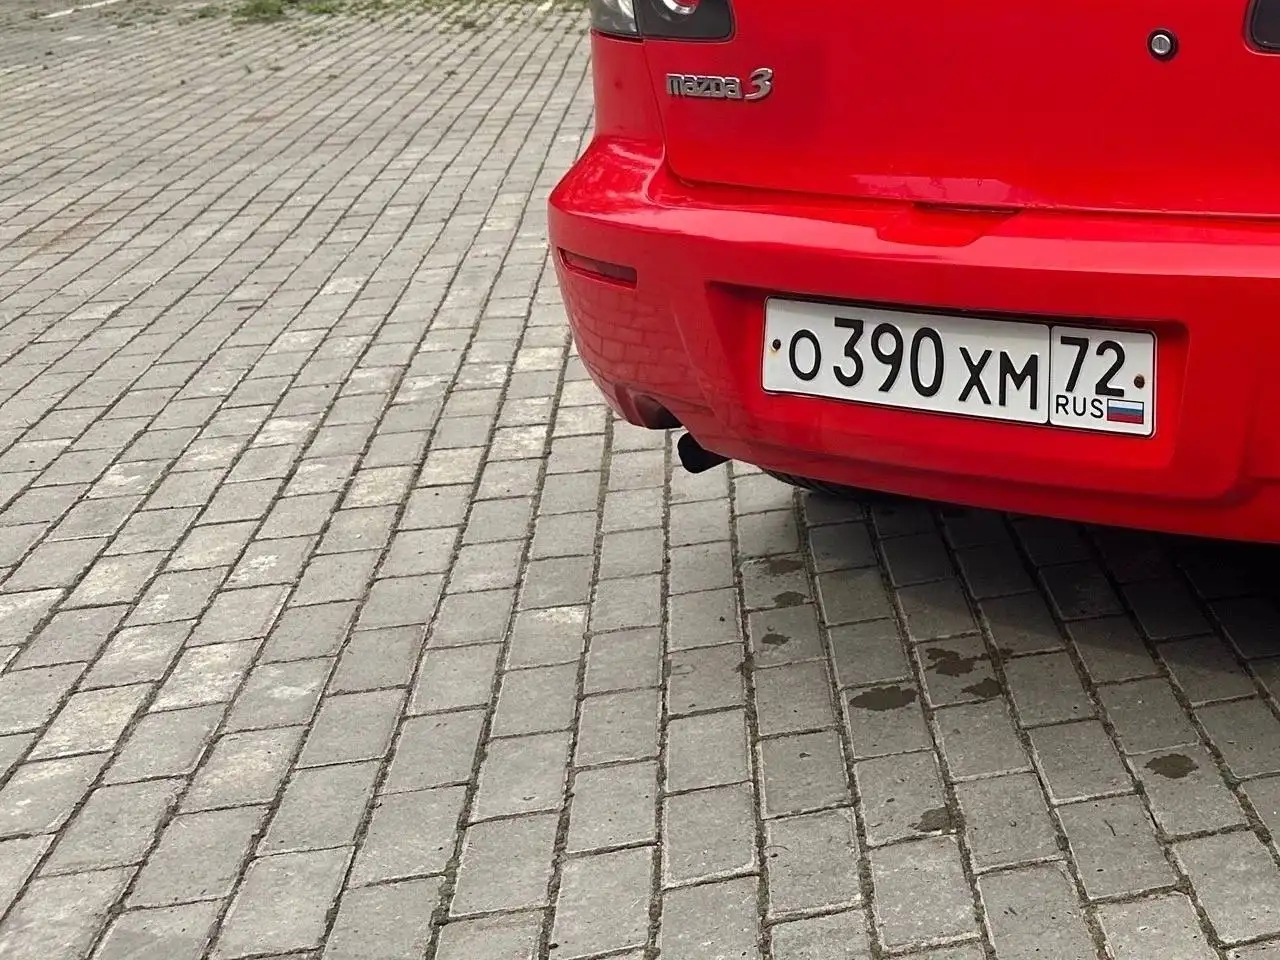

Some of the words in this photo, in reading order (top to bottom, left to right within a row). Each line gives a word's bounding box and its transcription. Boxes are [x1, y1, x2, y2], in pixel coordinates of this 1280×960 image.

[743, 67, 773, 100] 3
[1060, 336, 1126, 398] 72
[1055, 394, 1105, 420] RUS
